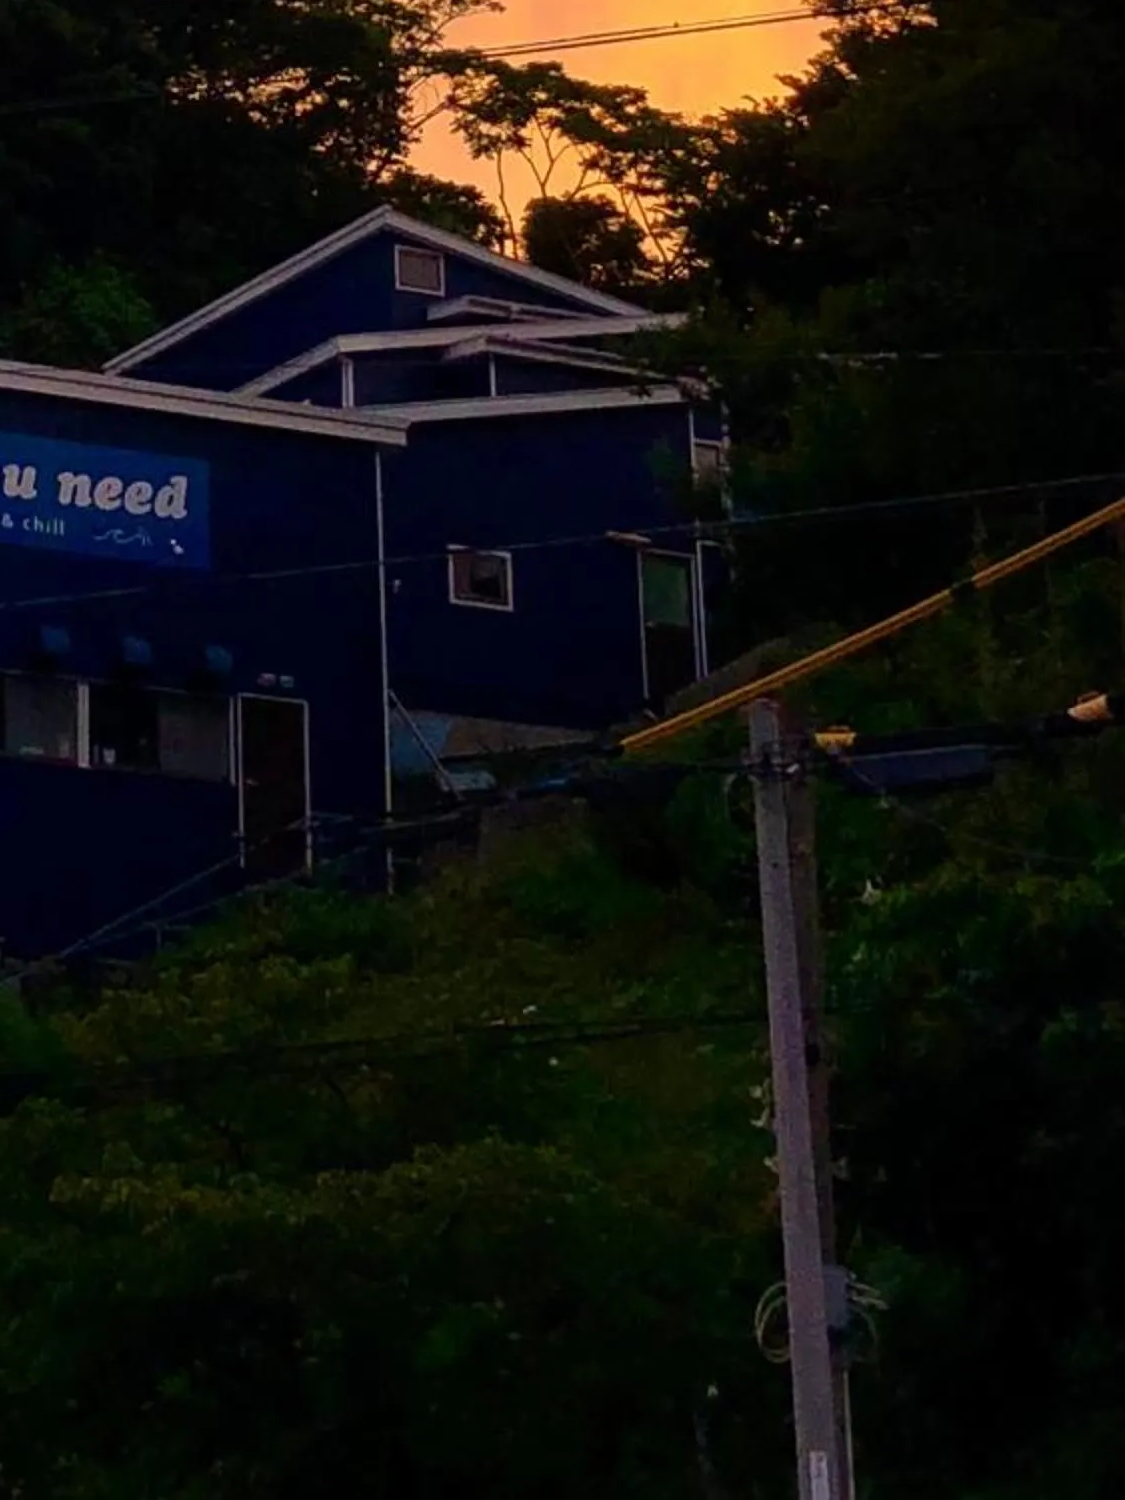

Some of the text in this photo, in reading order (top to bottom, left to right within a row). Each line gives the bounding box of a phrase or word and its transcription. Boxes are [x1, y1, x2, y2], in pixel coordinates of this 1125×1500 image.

[56, 471, 188, 520] need
[0, 513, 15, 530] &
[22, 516, 66, 537] chill
